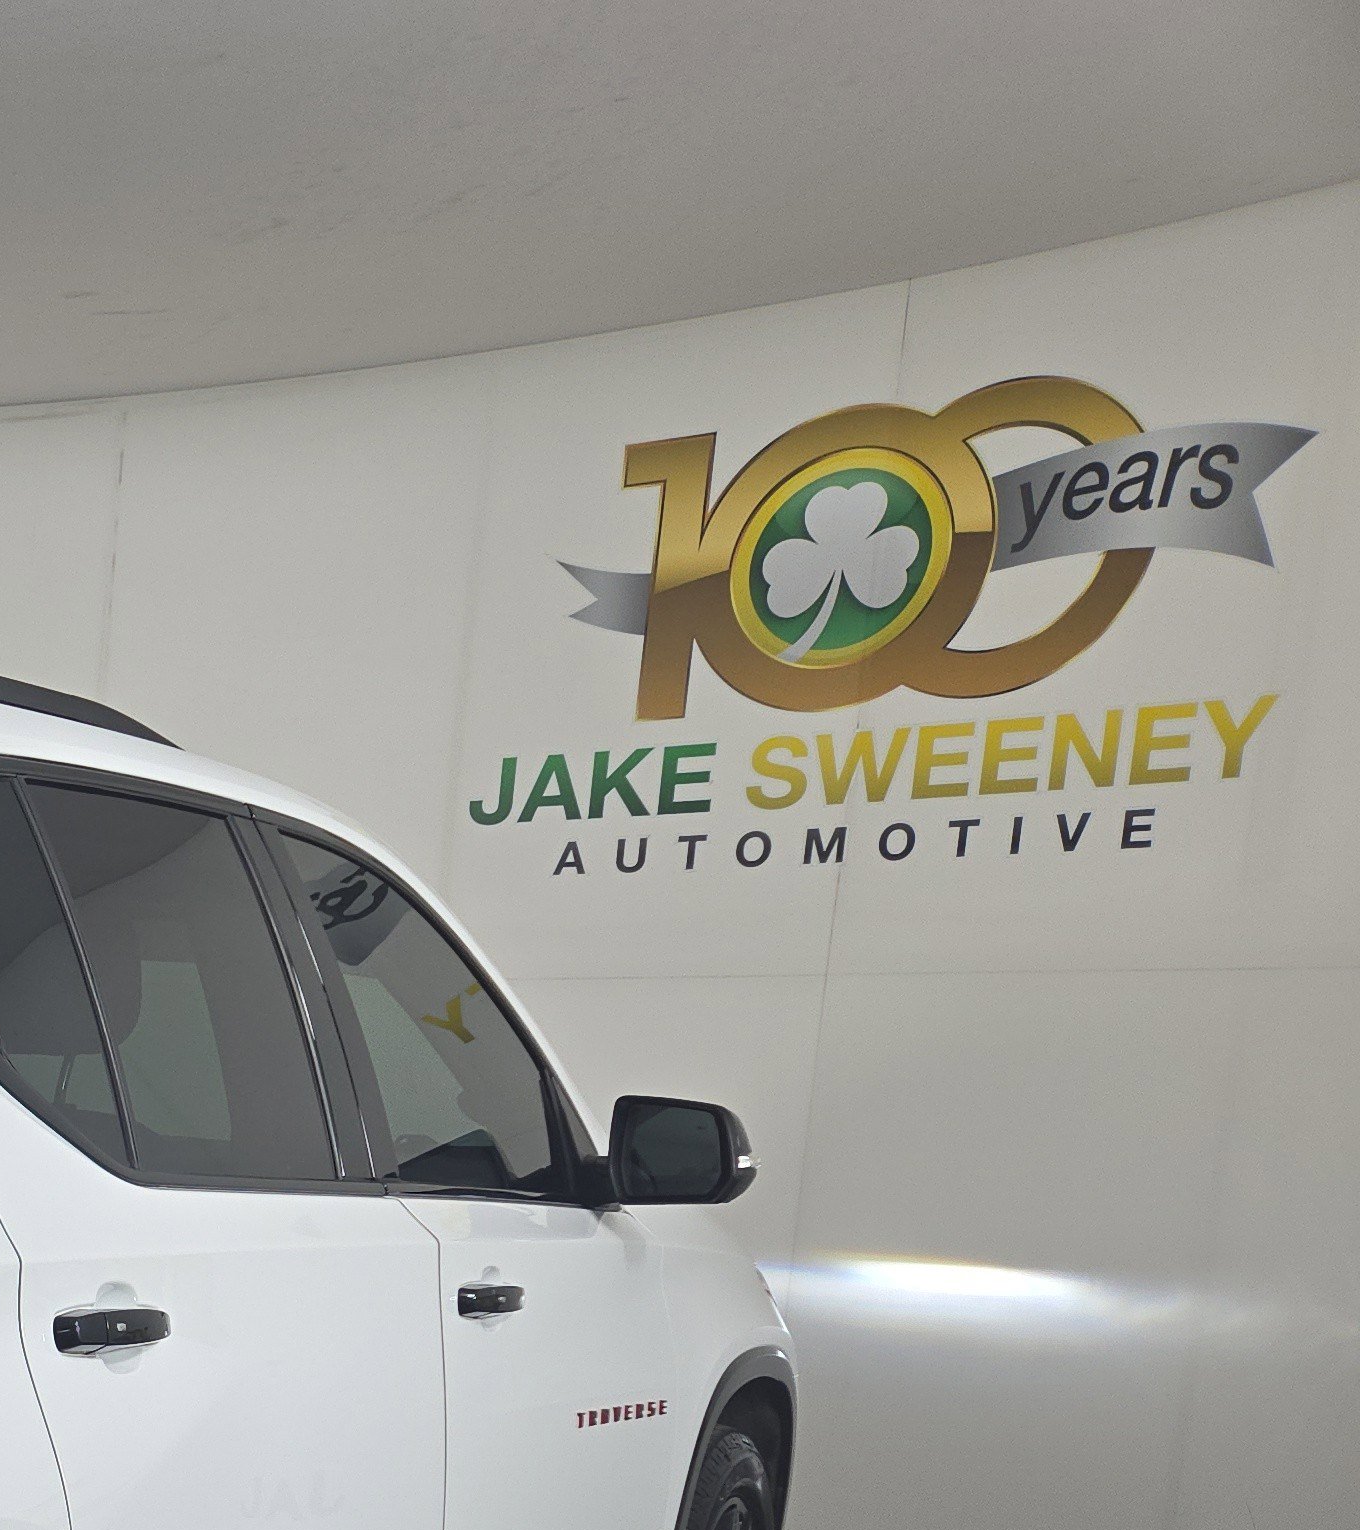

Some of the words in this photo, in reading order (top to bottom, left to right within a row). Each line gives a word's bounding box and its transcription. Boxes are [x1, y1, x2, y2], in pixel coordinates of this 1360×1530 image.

[623, 375, 1154, 721] 100
[1010, 442, 1238, 553] years
[469, 742, 718, 826] JAKE
[745, 695, 1279, 811] SWEENEY
[553, 808, 1156, 876] AUTOMOTIVE
[577, 1400, 668, 1429] TRAVERSE
